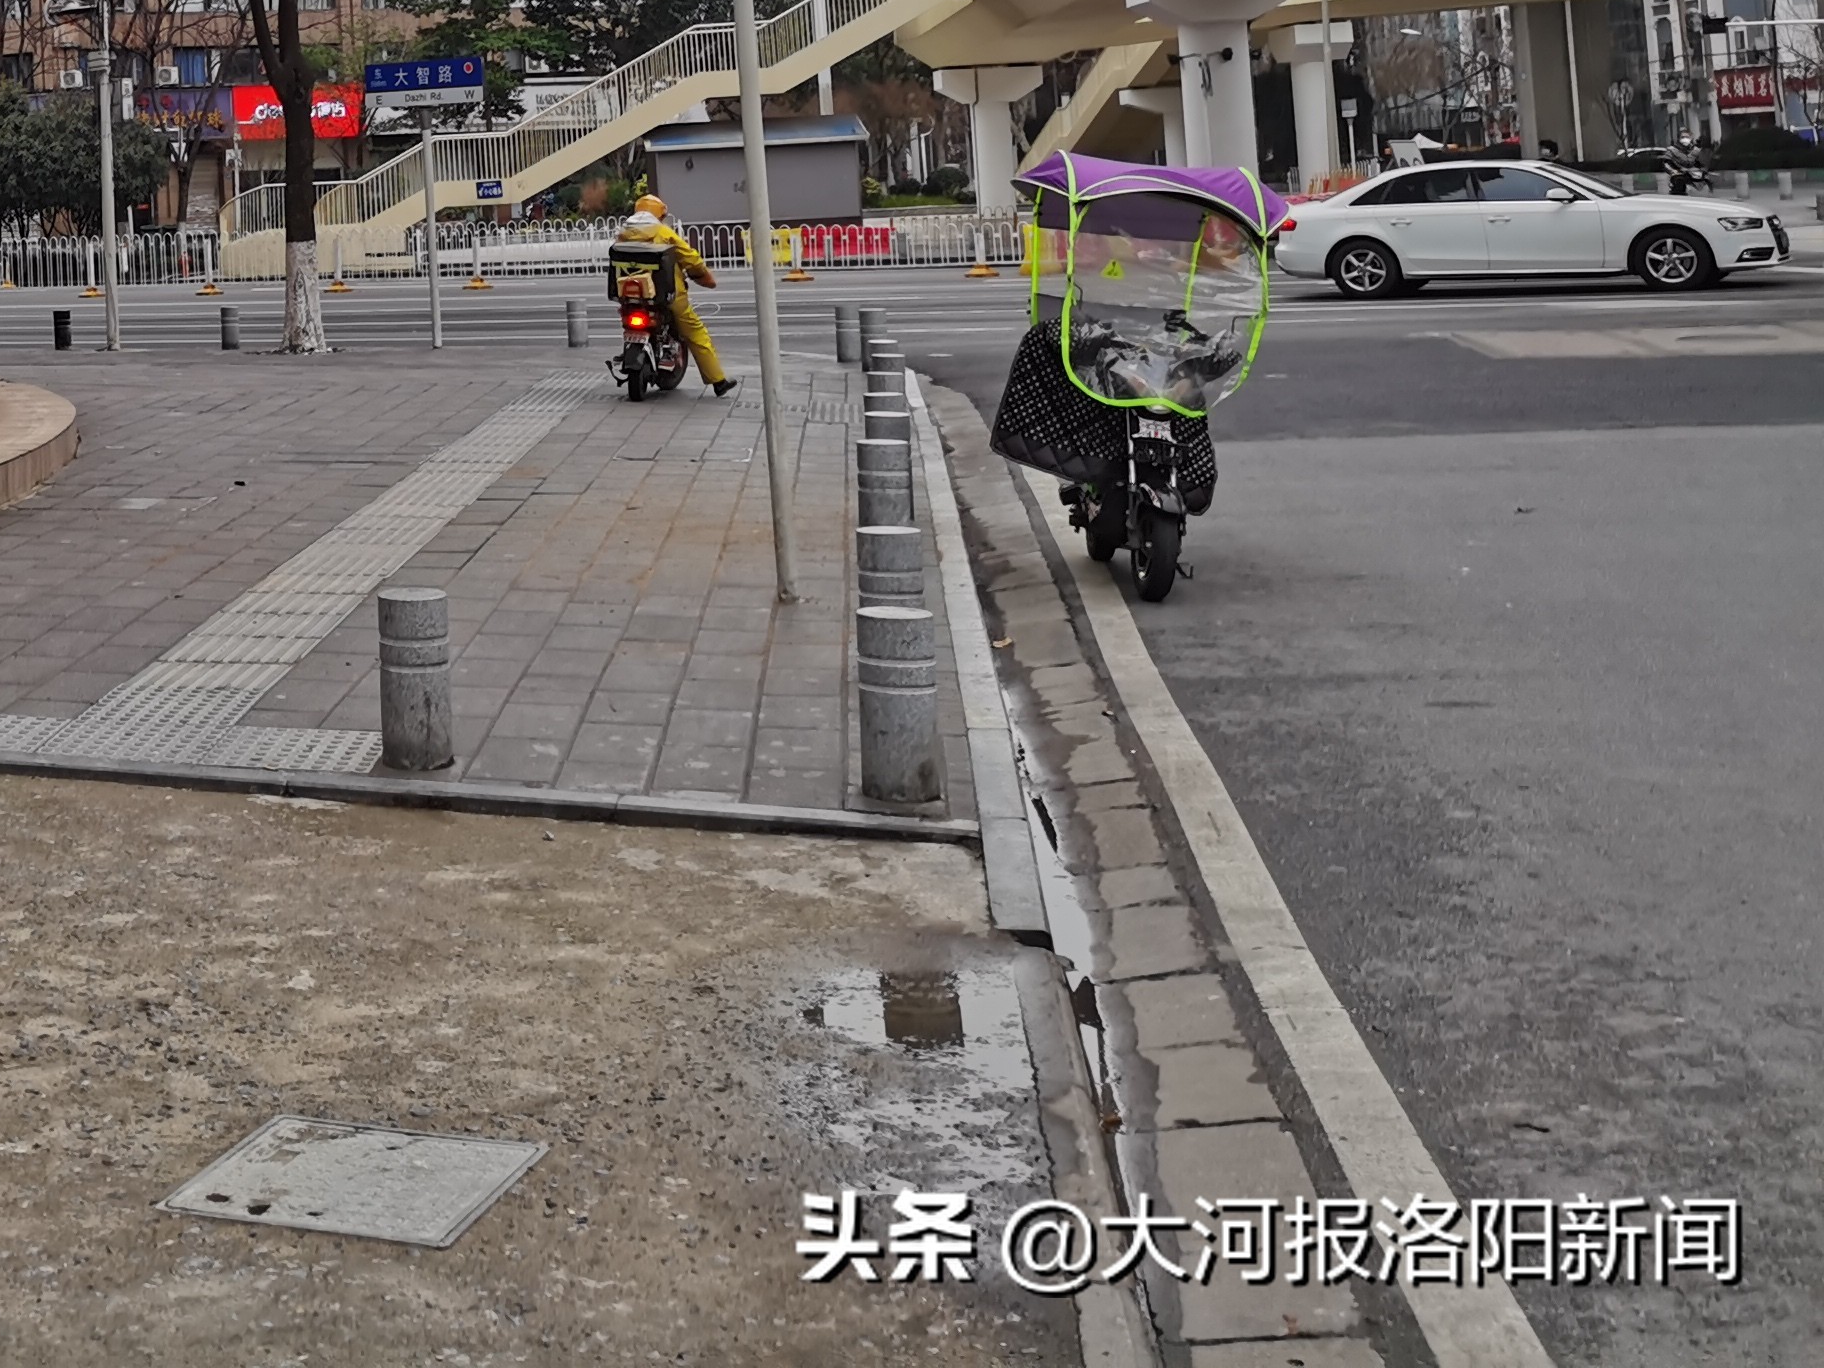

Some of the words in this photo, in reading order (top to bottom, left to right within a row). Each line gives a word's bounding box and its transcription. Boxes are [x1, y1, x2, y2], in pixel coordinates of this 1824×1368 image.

[394, 65, 453, 87] 大智路
[376, 95, 383, 105] E
[404, 93, 427, 103] Dazhi
[464, 90, 475, 99] W
